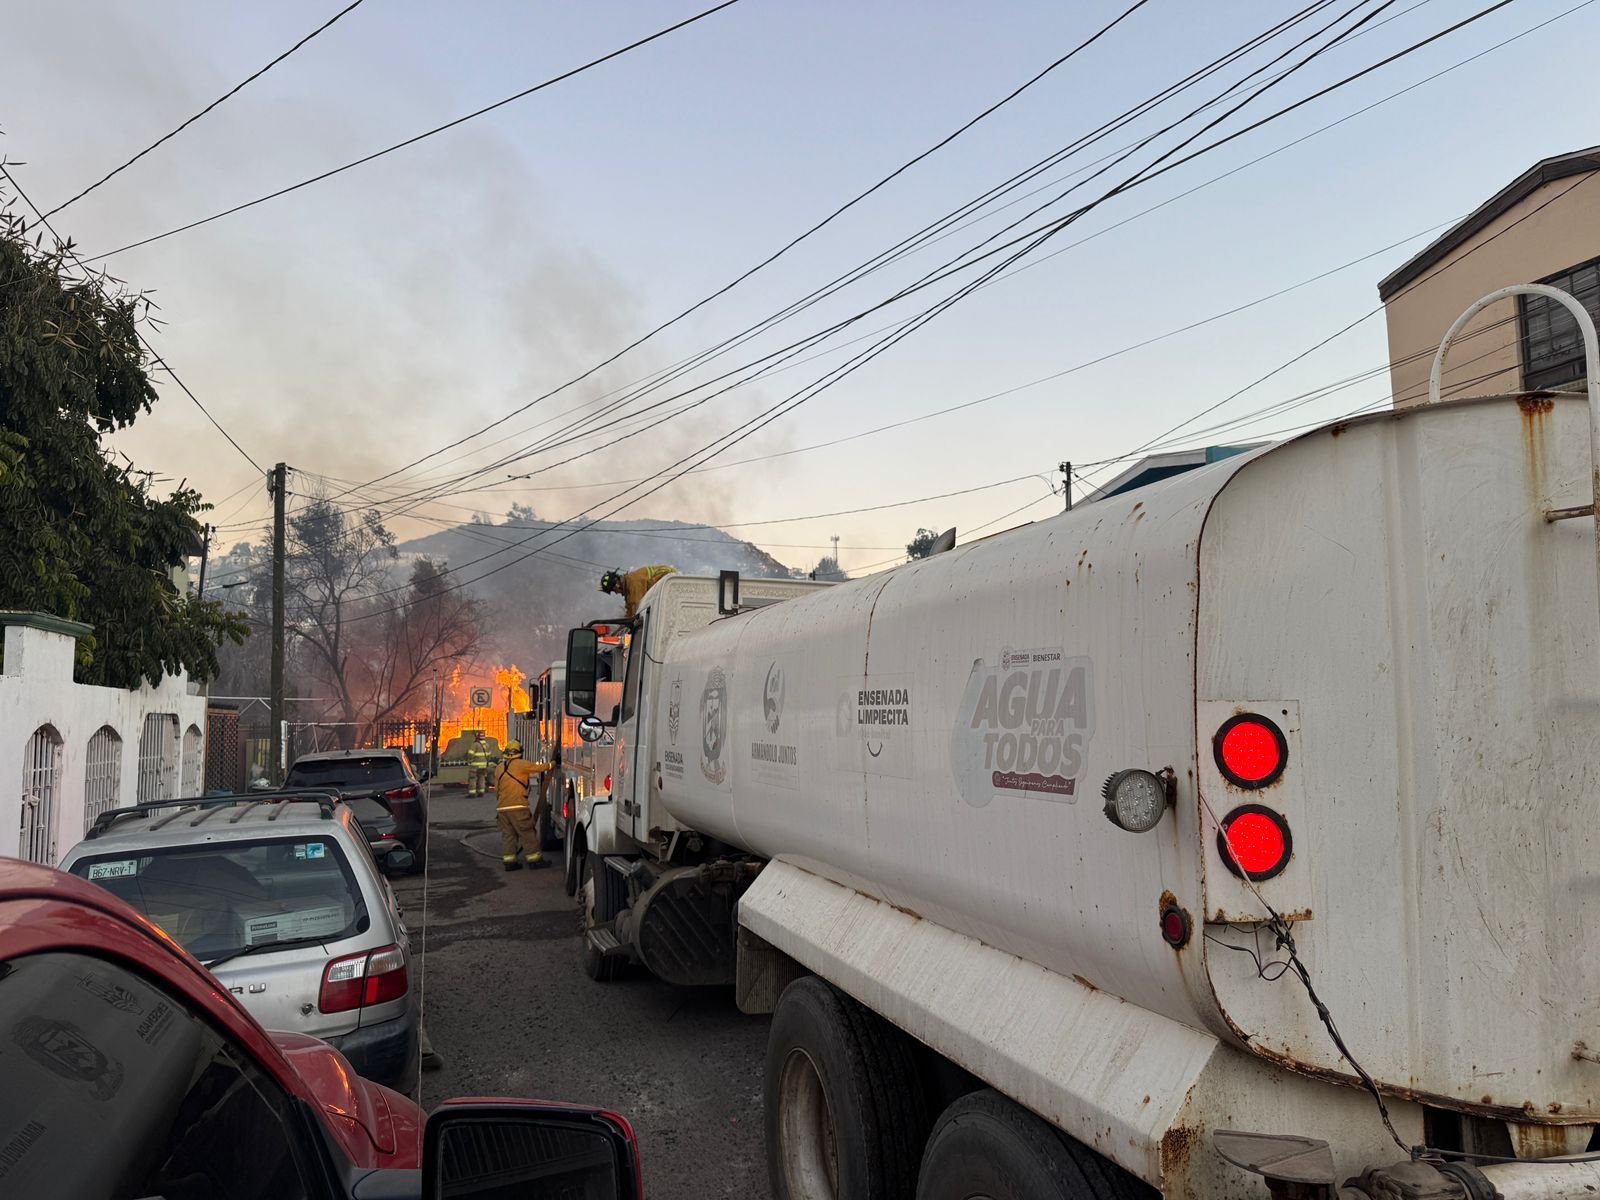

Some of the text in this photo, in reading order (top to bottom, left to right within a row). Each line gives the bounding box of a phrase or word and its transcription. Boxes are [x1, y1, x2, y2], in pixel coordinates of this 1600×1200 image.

[1032, 653, 1061, 662] BIENESTAR
[858, 689, 909, 706] ENSENADA
[971, 667, 1087, 729] AGUA
[858, 709, 909, 726] LIMPIECITA
[1030, 719, 1064, 737] PARA
[778, 745, 797, 766] JUNTOS
[983, 733, 1081, 777] TODOS
